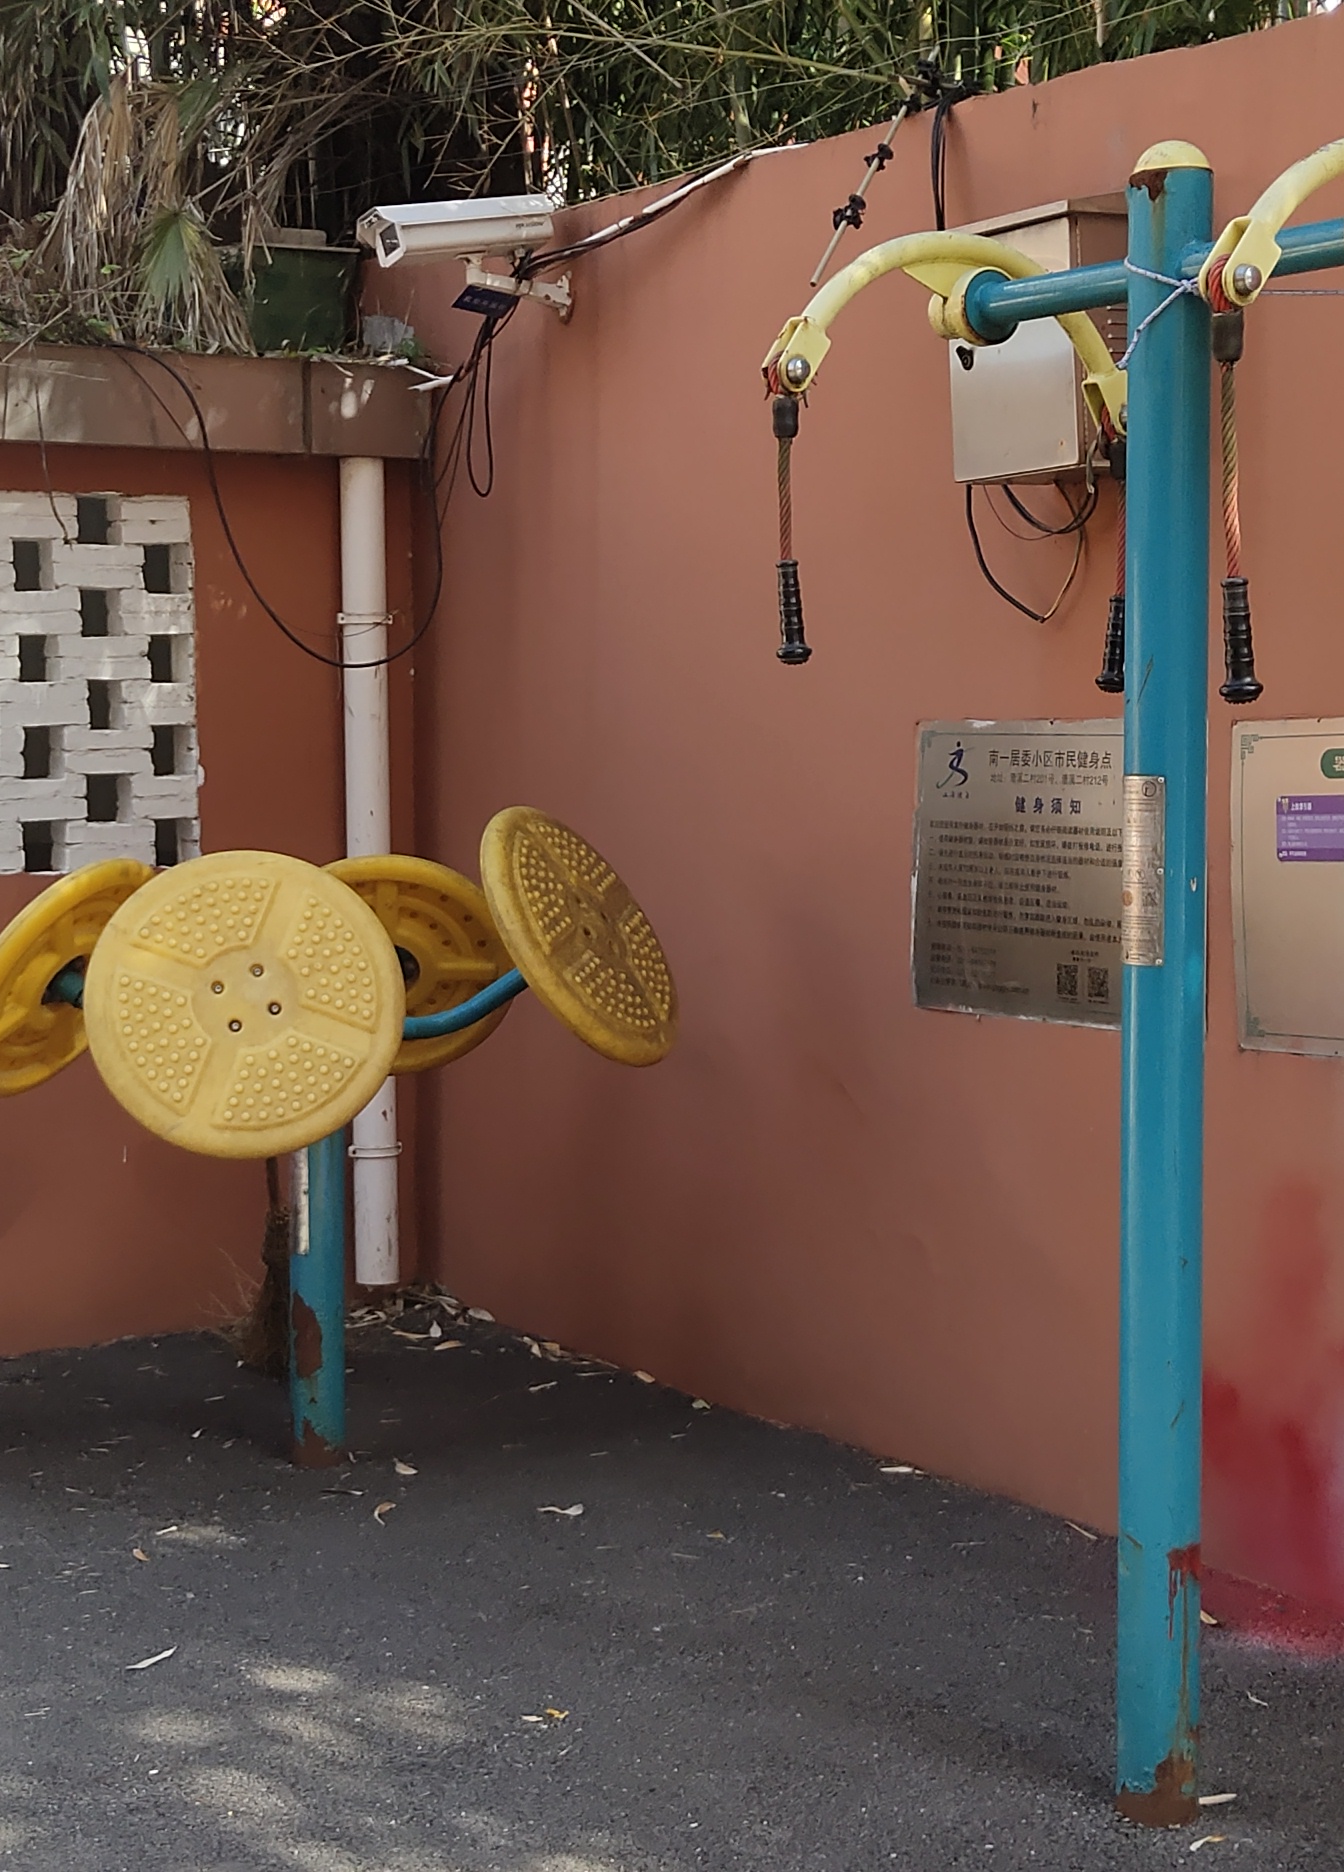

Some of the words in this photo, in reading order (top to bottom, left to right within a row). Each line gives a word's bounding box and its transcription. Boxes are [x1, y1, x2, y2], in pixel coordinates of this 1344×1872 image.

[988, 749, 1113, 769] 南一居委小区市民健身点
[1014, 795, 1082, 815] 健身须知
